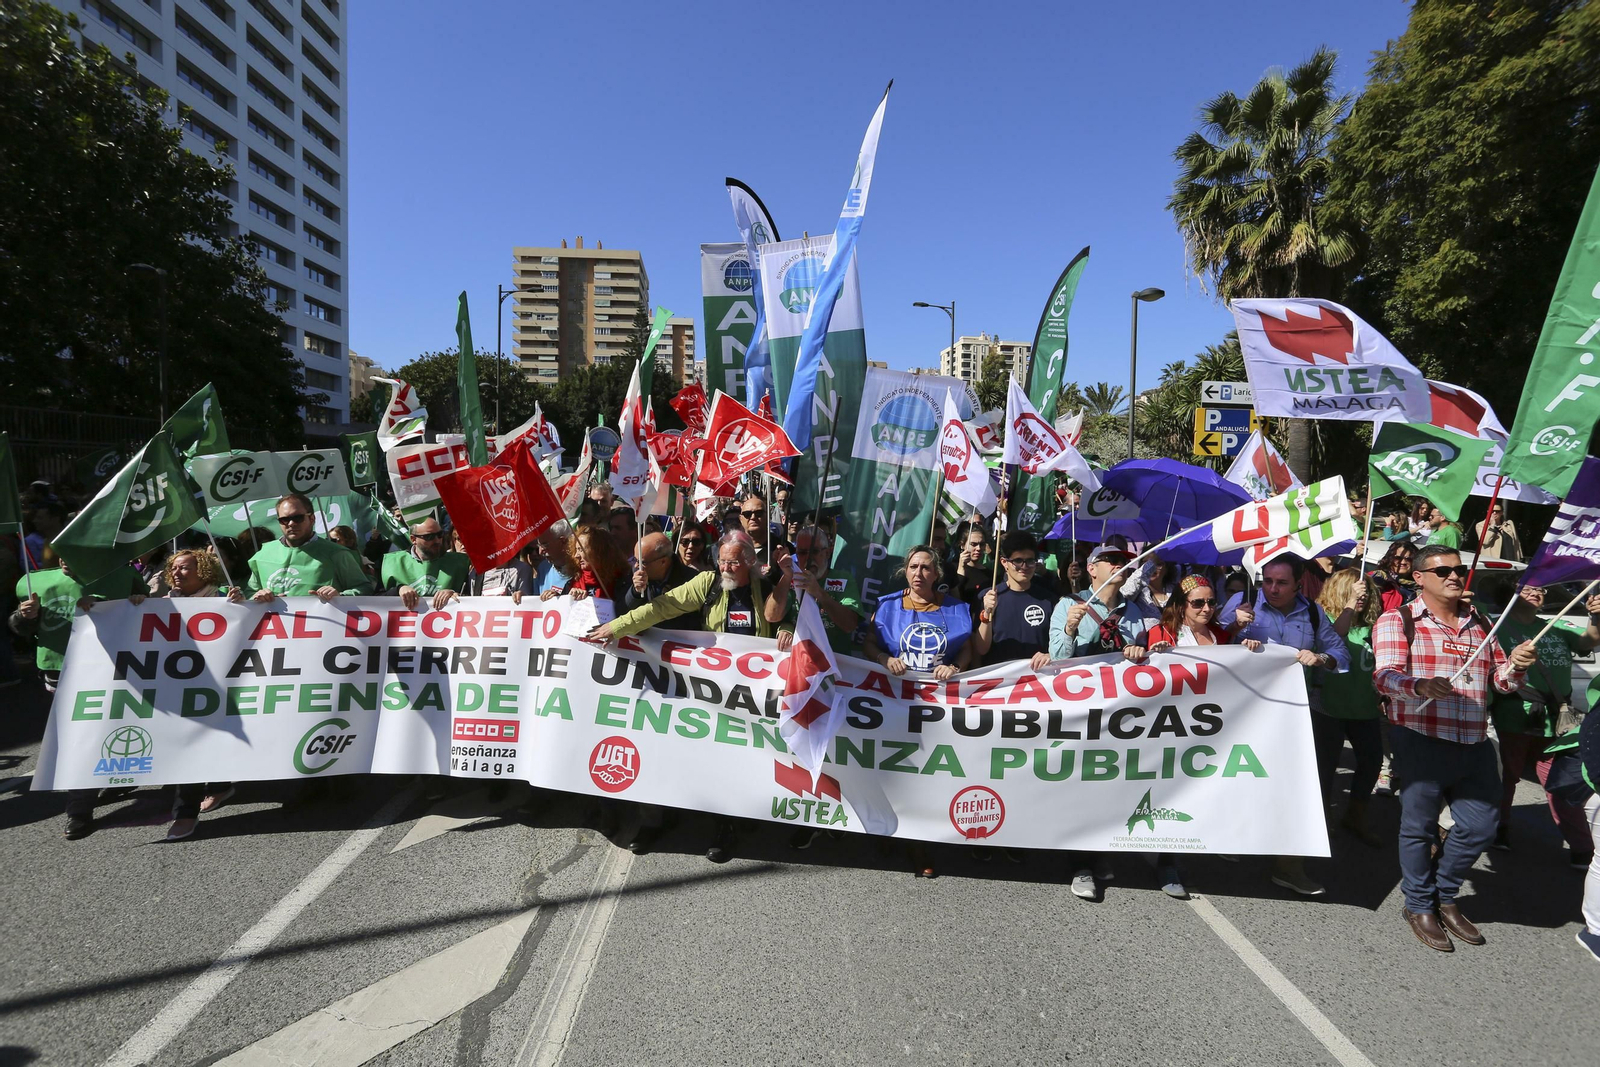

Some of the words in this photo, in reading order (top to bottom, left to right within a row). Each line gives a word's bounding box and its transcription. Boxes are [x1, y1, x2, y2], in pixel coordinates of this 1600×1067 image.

[774, 253, 799, 280] SINDICATO
[800, 250, 828, 258] INDEPEN
[1284, 367, 1406, 393] USTEA
[874, 388, 904, 410] SINDICATO
[905, 388, 943, 420] INDEPENDIENTE
[1293, 395, 1407, 411] MÁLAGA
[1205, 410, 1221, 430] P
[878, 425, 926, 446] ANPE
[1222, 434, 1238, 455] P
[592, 442, 614, 453] ANPE
[1391, 457, 1447, 485] CSIF
[139, 612, 228, 641] NO
[248, 611, 322, 640] AL
[345, 609, 561, 640] DECRETO
[113, 649, 206, 680] NO
[225, 647, 301, 678] AL
[323, 645, 508, 675] CIERRE
[528, 647, 571, 679] DE
[71, 689, 157, 722] EN
[180, 682, 445, 718] DEFENSA
[456, 682, 520, 714] DE
[594, 693, 966, 778] ENSEÑNZA
[990, 740, 1270, 782] PÚBLICA
[455, 723, 499, 737] CCOO
[305, 734, 357, 756] CSIF
[451, 744, 517, 759] enseñanza
[93, 757, 153, 773] ANPE
[451, 757, 515, 776] Málaga
[599, 744, 636, 768] UGT
[771, 796, 848, 827] USTEA
[955, 797, 996, 814] FRENTE
[957, 812, 1000, 825] ESTUDIANTES
